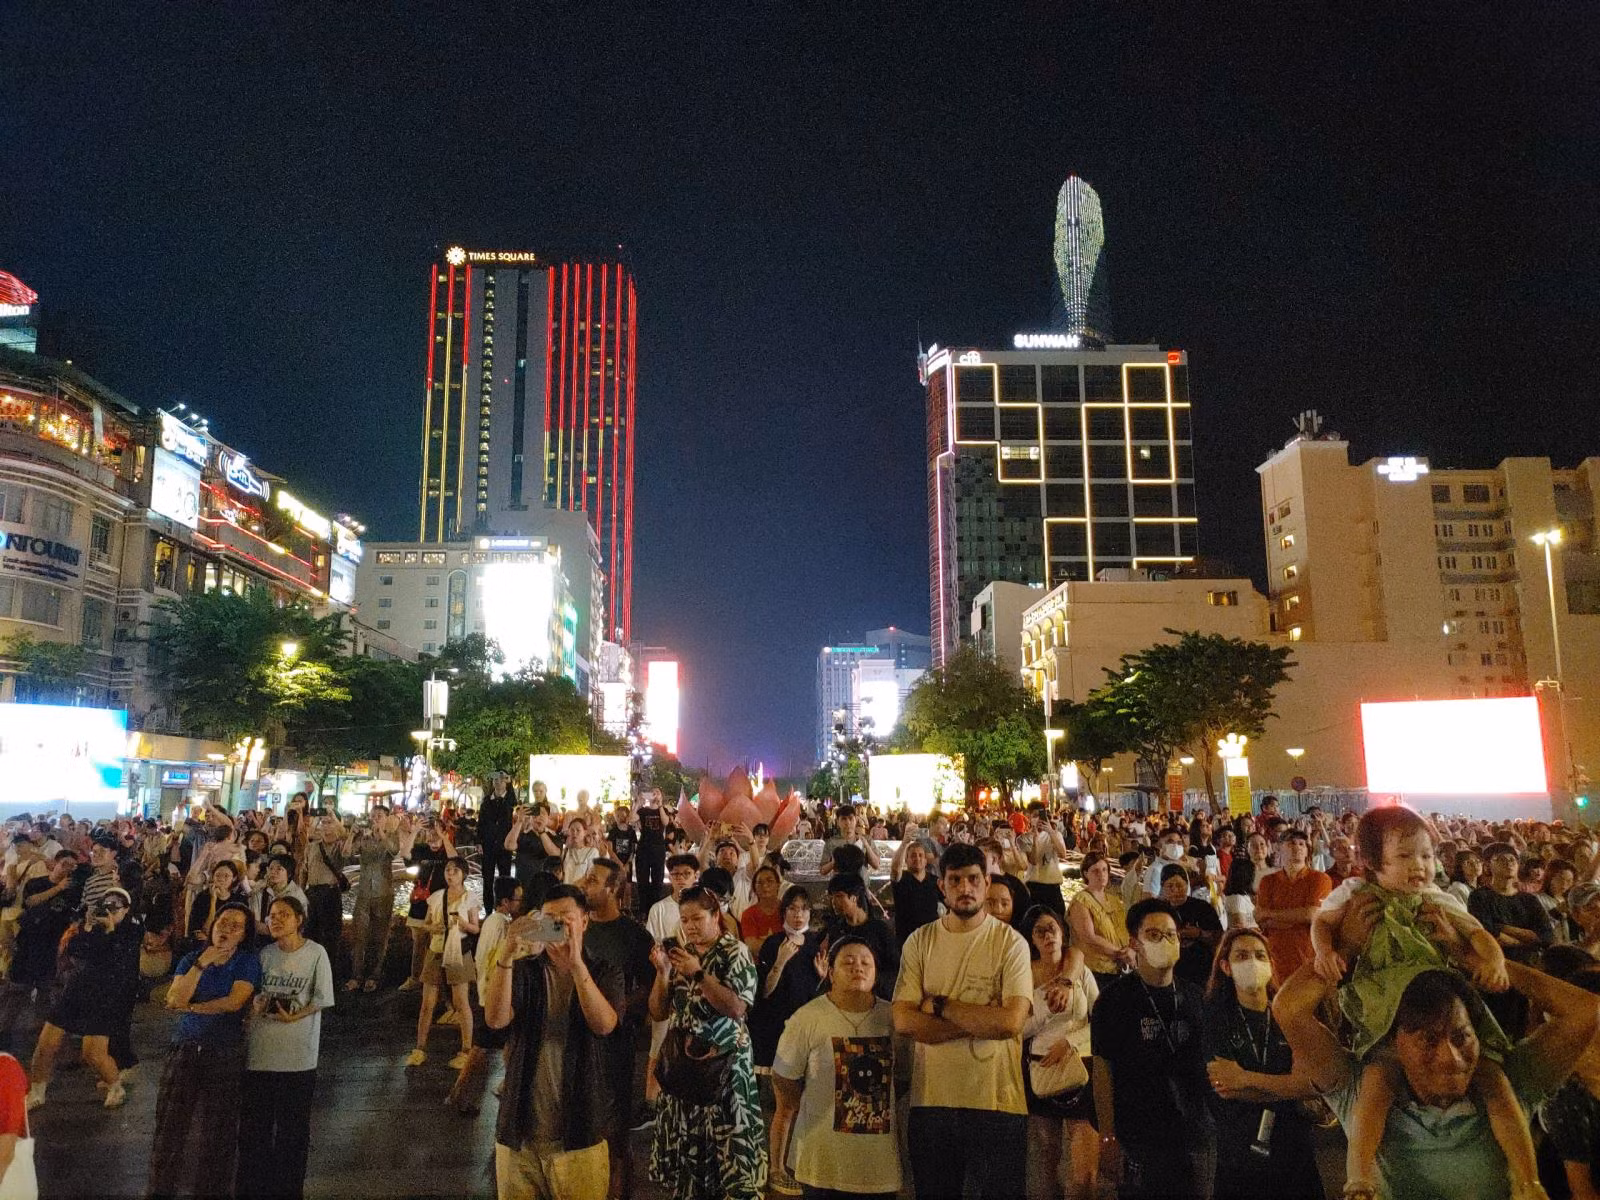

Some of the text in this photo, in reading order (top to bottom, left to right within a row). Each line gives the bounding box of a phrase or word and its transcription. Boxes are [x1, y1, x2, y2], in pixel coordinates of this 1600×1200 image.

[468, 252, 535, 262] TIMES SQUARE
[1014, 334, 1078, 348] SUNWAH
